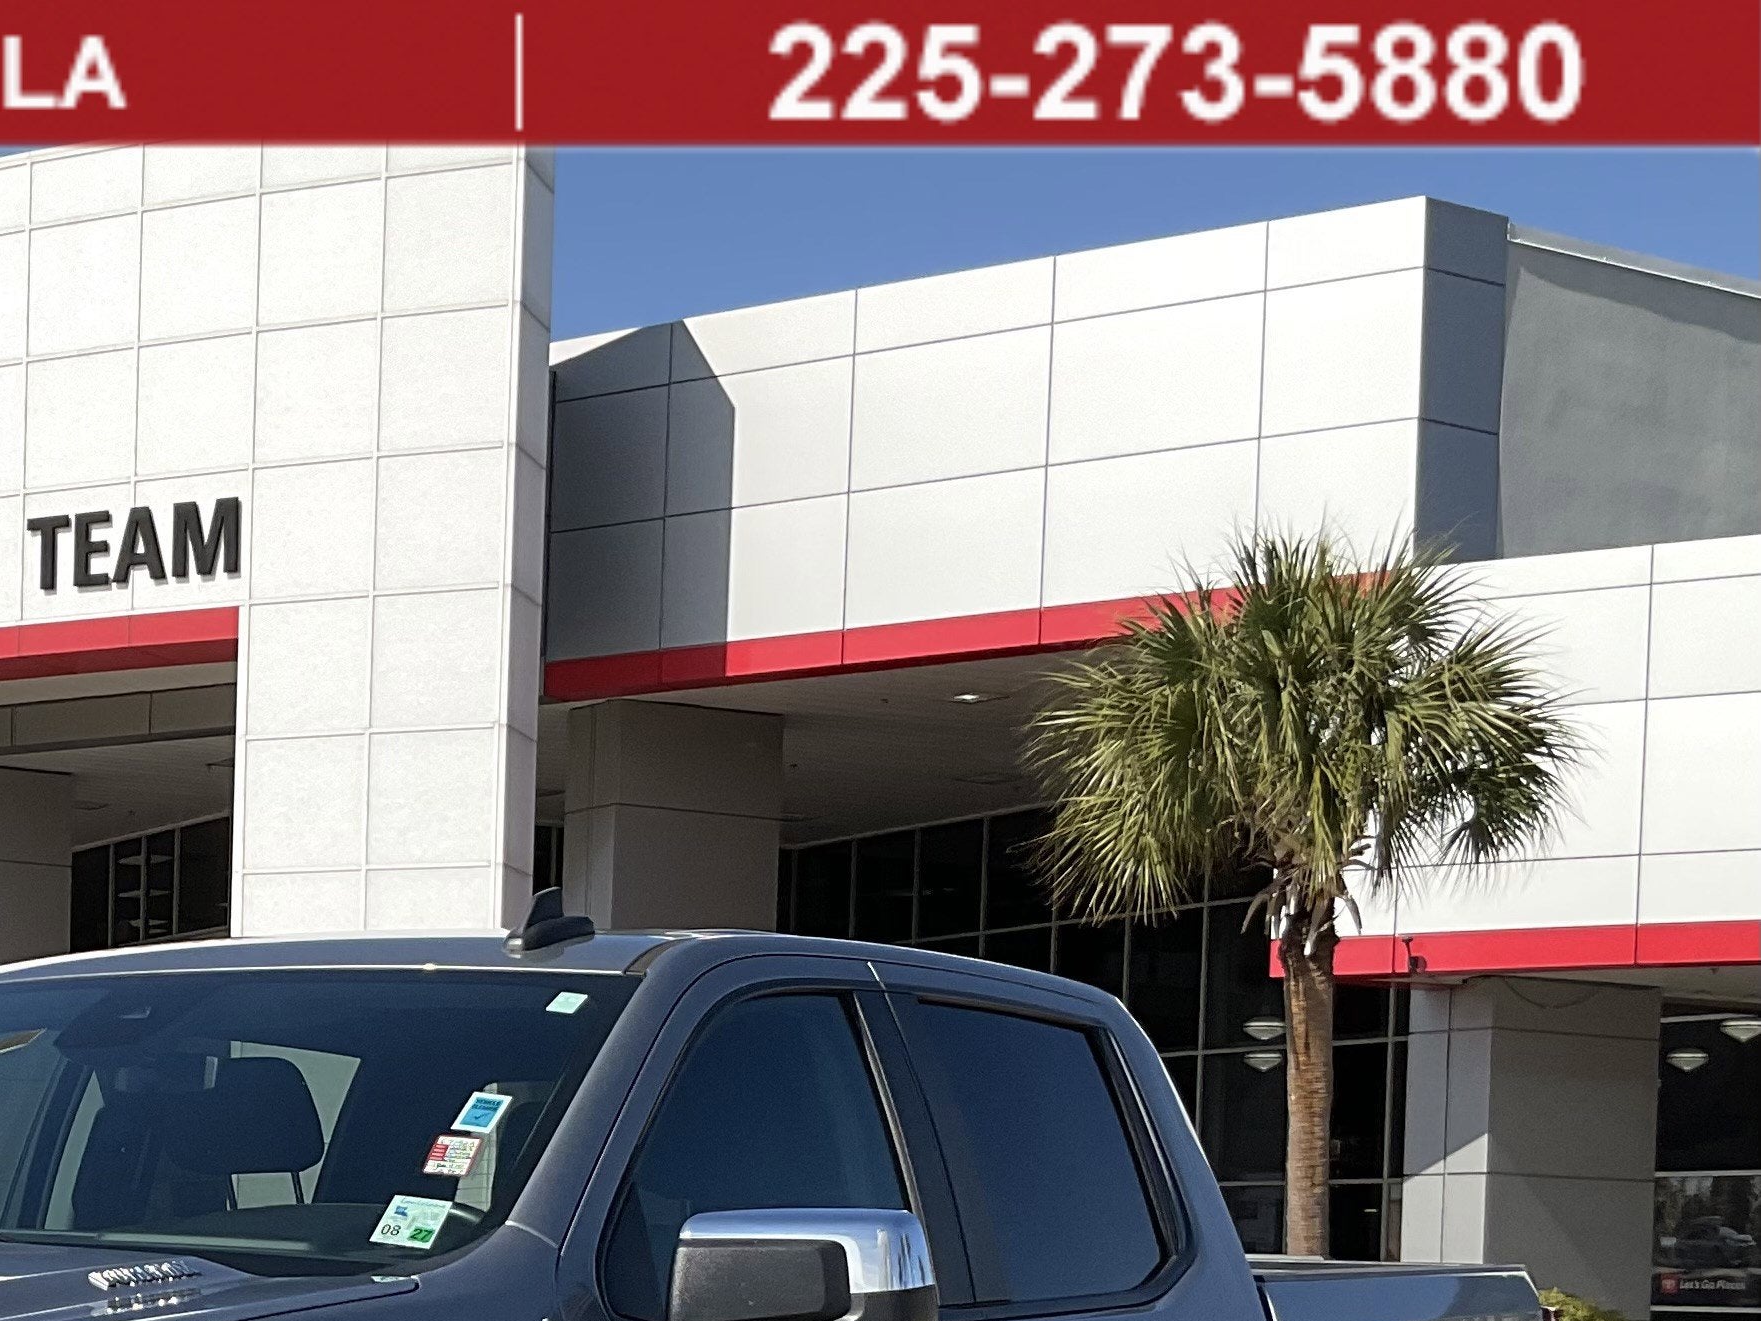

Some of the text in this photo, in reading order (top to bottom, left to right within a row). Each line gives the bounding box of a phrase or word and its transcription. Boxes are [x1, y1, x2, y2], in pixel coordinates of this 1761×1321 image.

[26, 496, 240, 592] TEAM
[381, 1223, 401, 1236] 08
[410, 1228, 433, 1241] 27
